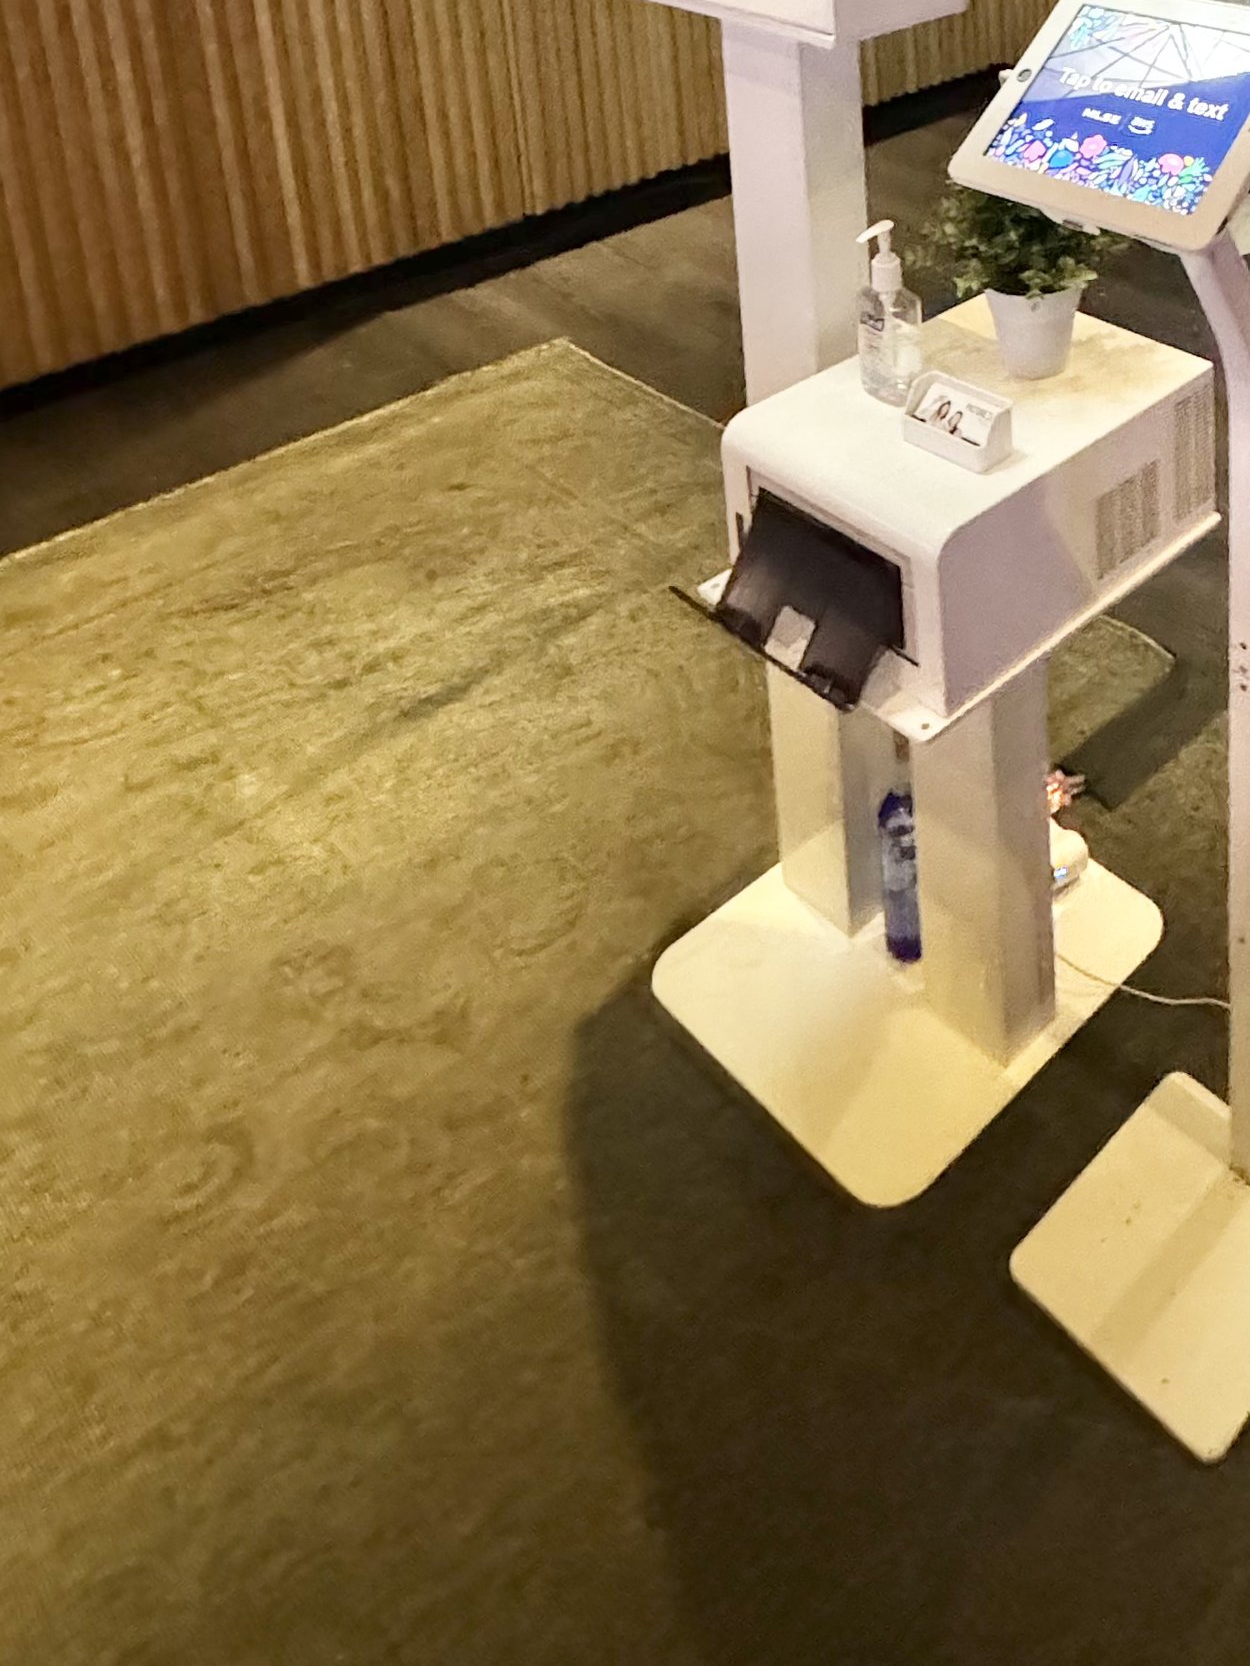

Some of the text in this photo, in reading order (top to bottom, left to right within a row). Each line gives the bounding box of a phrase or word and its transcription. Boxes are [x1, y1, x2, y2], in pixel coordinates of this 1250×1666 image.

[1059, 67, 1229, 121] Tap to email & text
